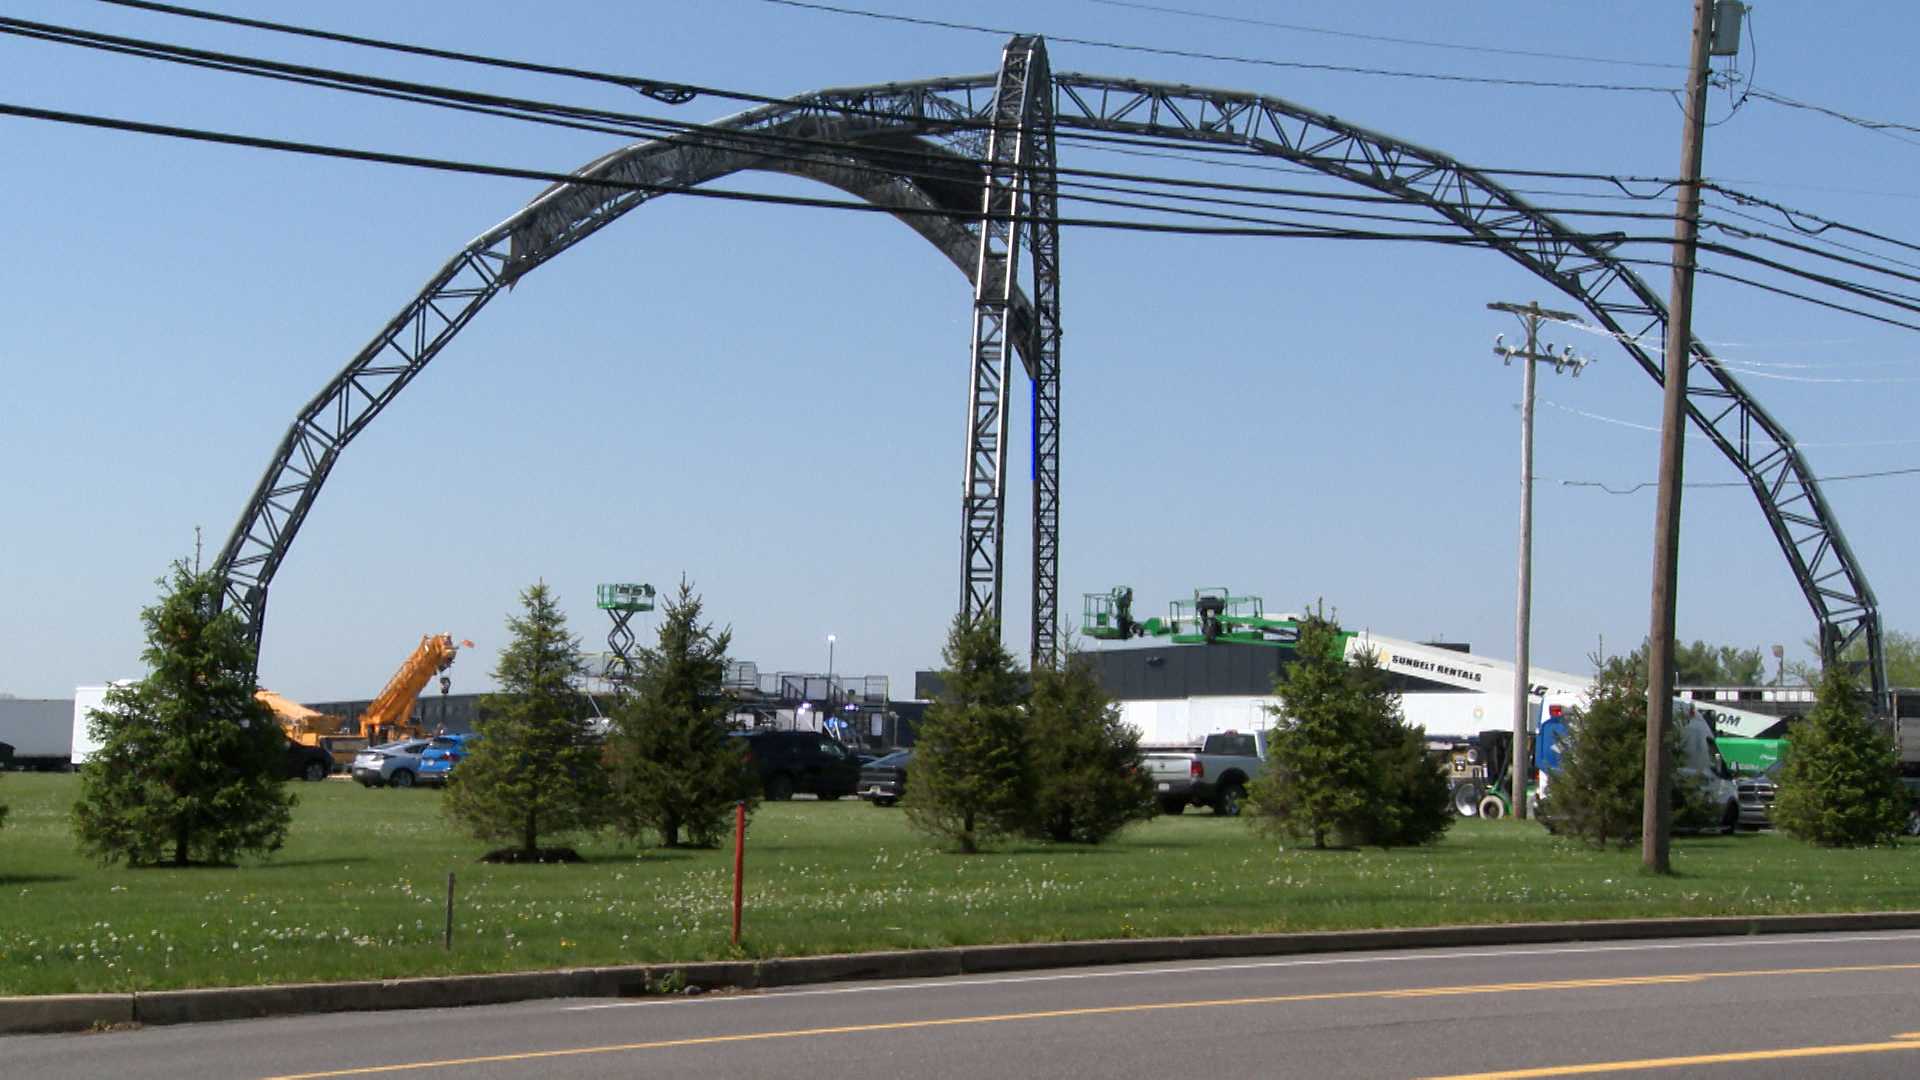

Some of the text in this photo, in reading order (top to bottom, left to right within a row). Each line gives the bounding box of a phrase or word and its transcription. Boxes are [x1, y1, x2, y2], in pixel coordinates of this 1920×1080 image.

[1392, 655, 1482, 681] SUNBELT RENTALS
[1528, 683, 1549, 696] LG
[1715, 712, 1741, 727] OM
